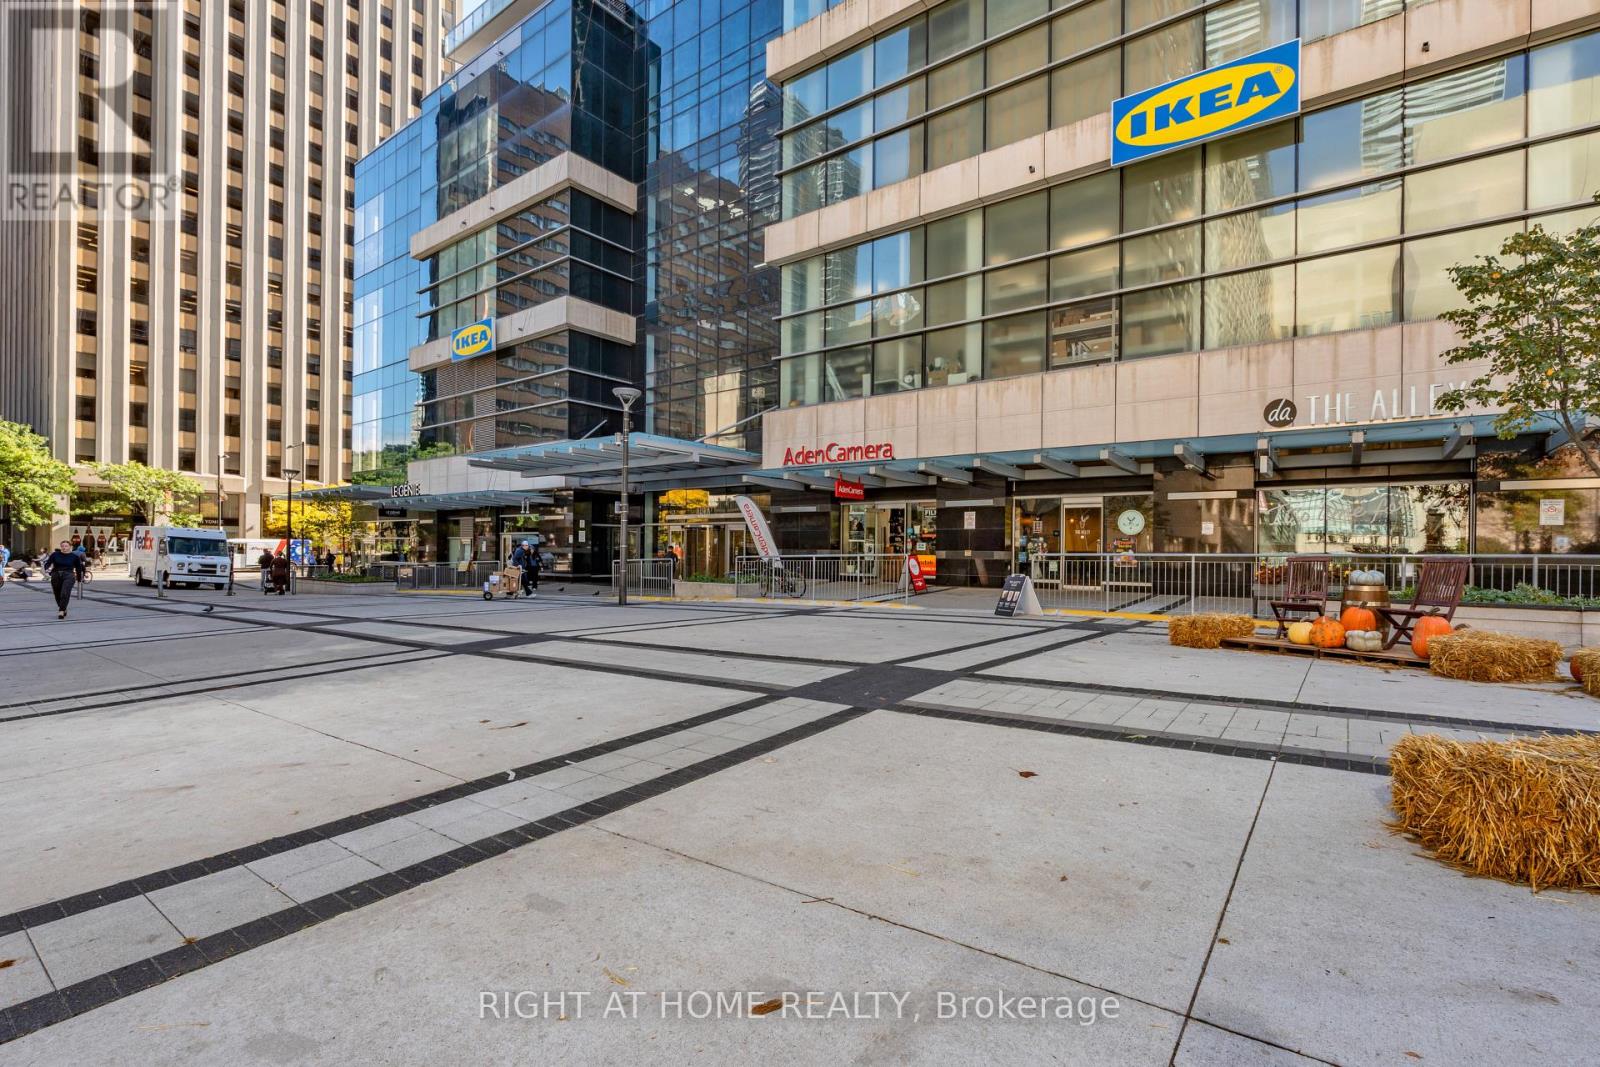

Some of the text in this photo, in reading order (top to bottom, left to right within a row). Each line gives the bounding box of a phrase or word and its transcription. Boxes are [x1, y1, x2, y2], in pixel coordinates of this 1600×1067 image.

[1130, 70, 1281, 139] IKEA
[455, 330, 488, 350] IKEA
[1305, 392, 1358, 424] THE
[783, 442, 893, 466] AdenCamera
[838, 485, 864, 495] AdenCamera
[134, 529, 154, 552] FedEx
